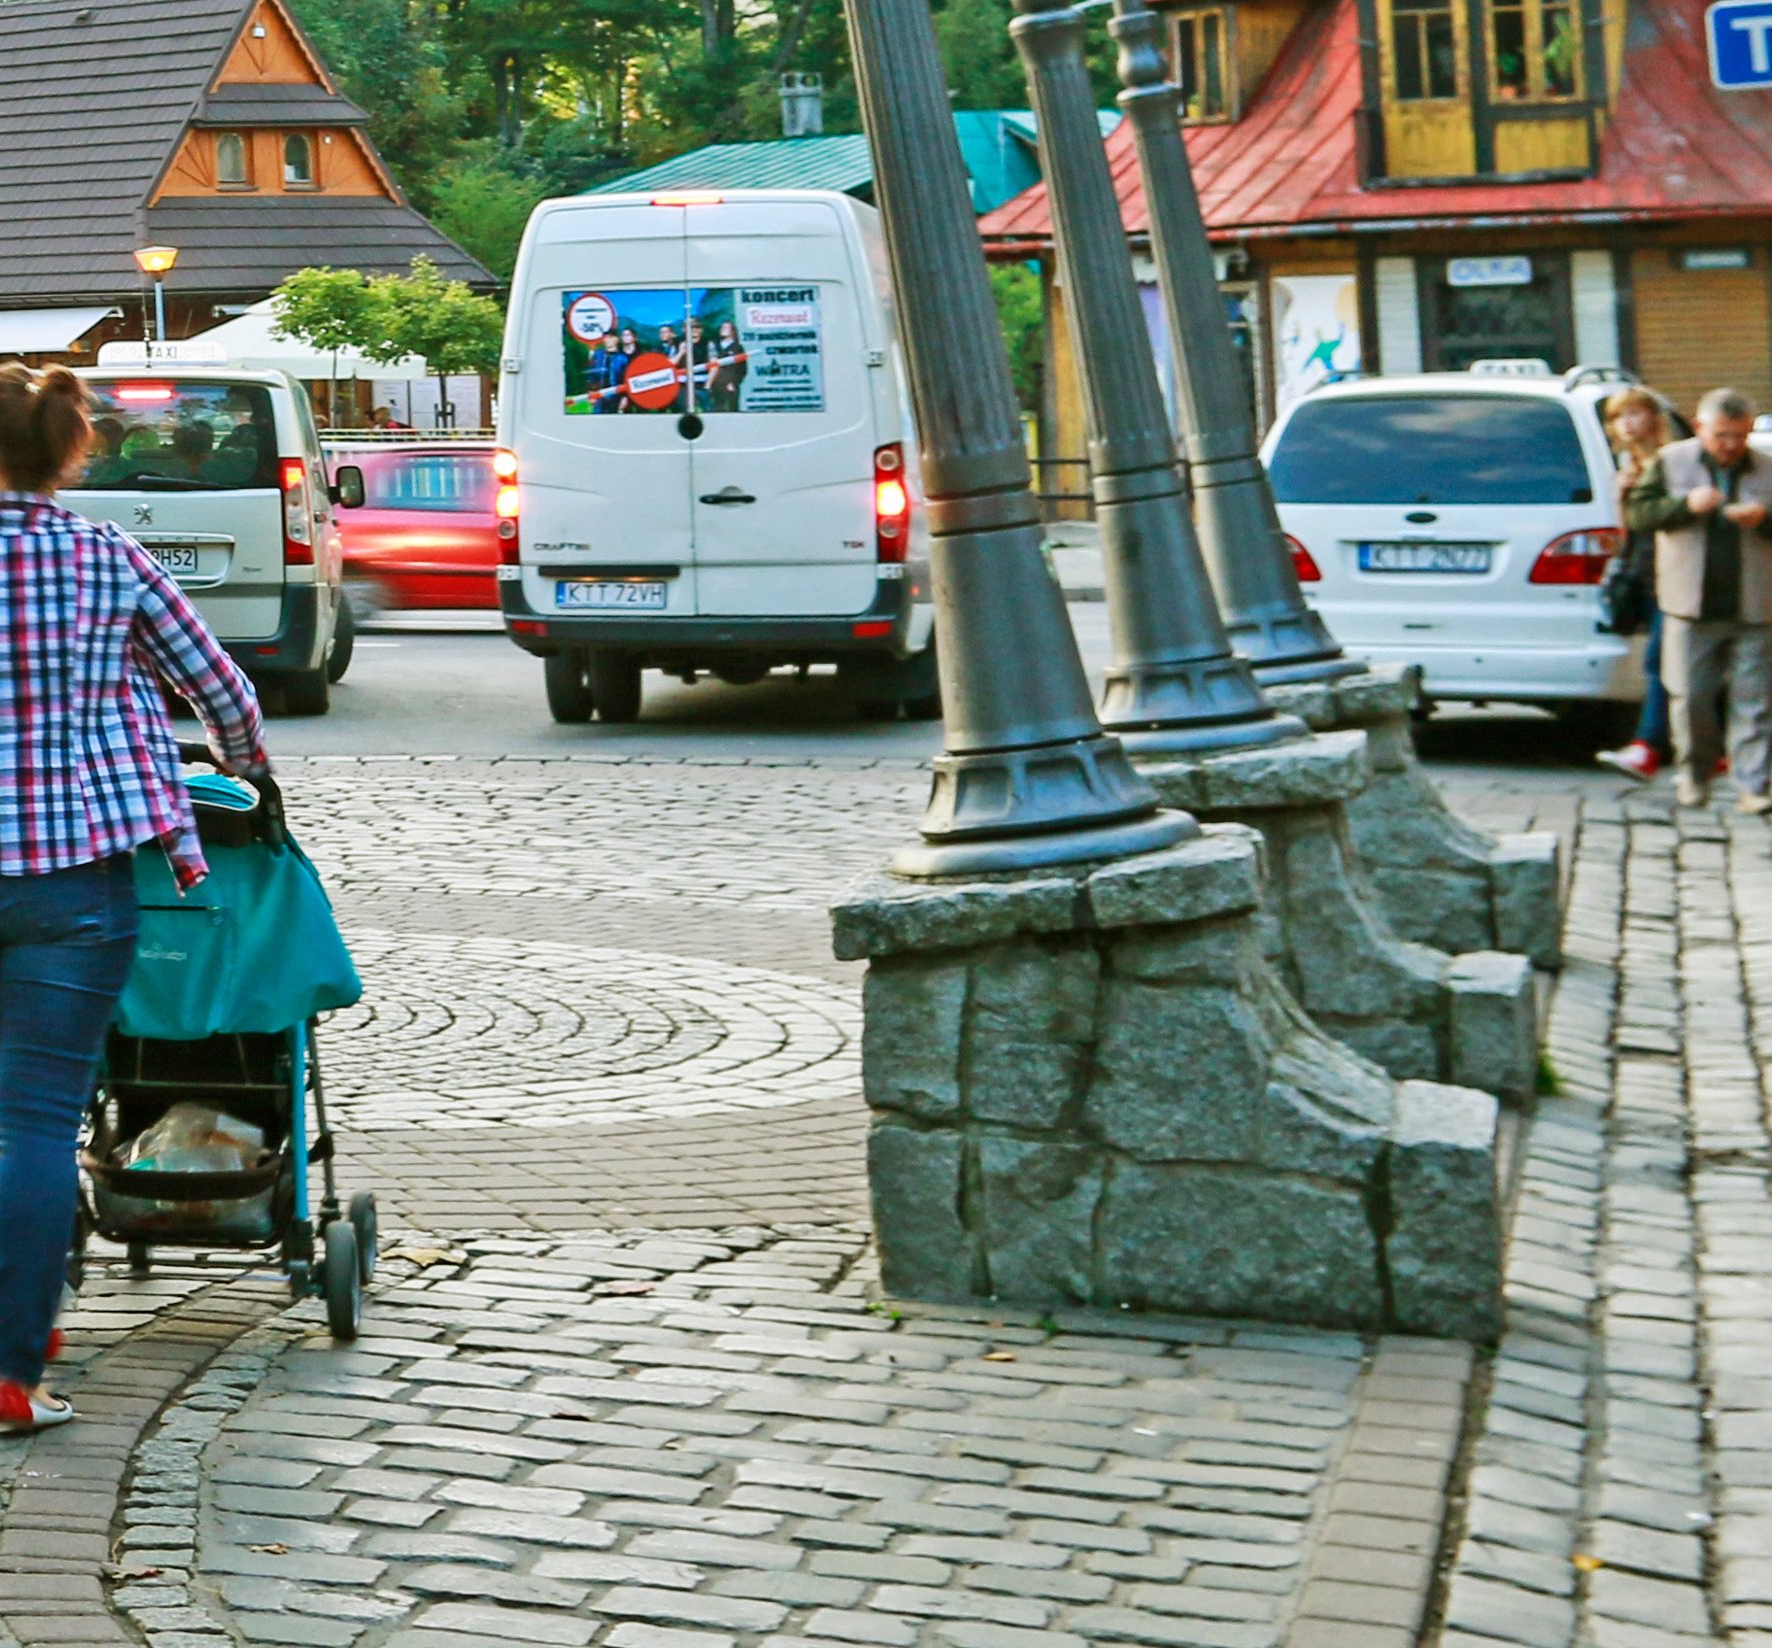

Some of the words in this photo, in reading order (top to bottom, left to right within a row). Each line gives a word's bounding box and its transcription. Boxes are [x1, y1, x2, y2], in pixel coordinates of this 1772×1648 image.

[741, 290, 814, 303] koncert
[568, 584, 607, 602] KTT
[616, 584, 663, 602] 72VH
